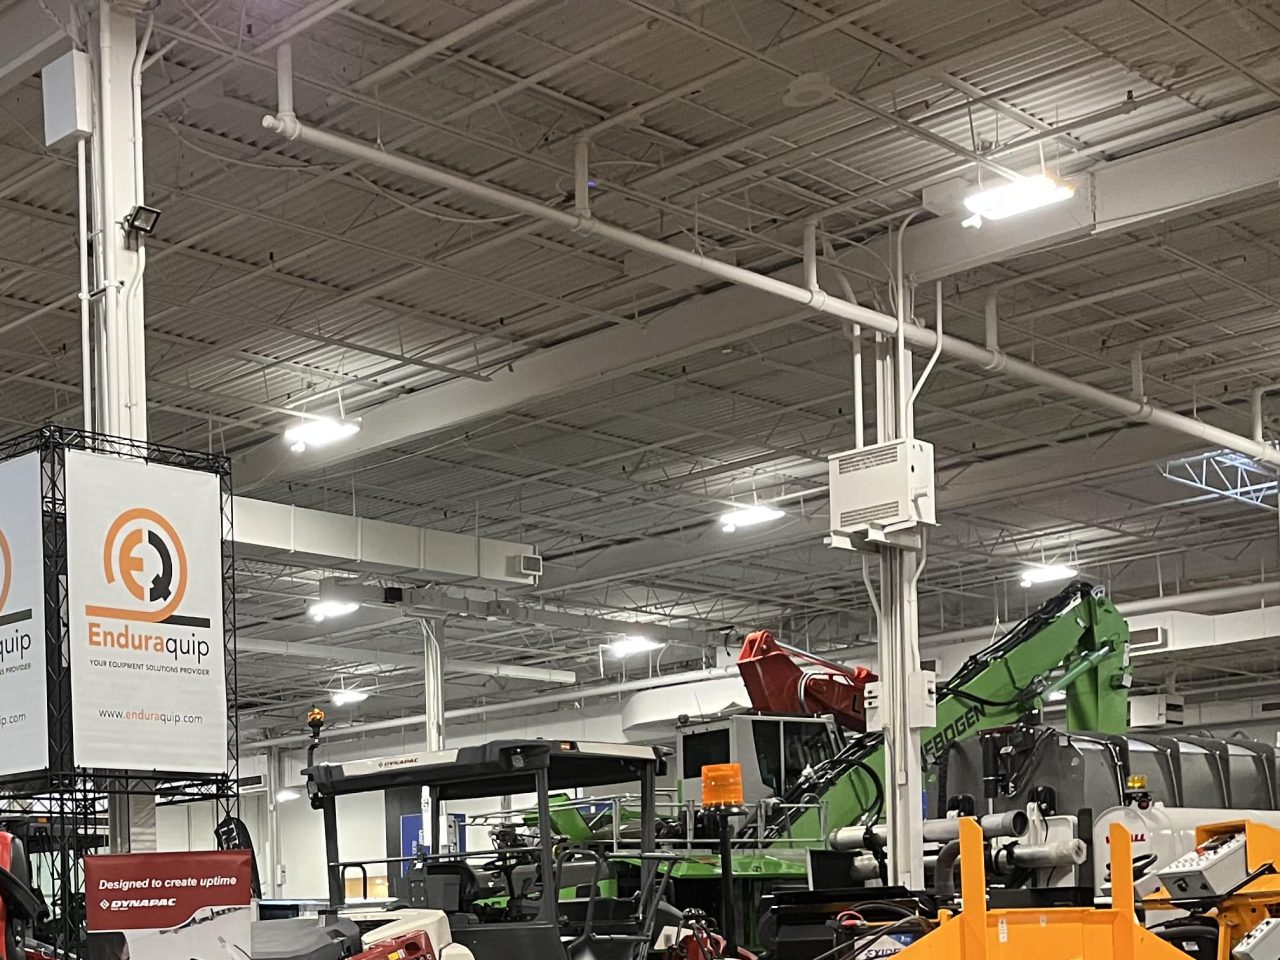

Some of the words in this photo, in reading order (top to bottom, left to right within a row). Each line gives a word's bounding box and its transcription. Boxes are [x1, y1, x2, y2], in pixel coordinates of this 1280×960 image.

[88, 622, 209, 664] Enduraquip
[6, 662, 32, 674] PROVIDER
[89, 659, 107, 667] YOUR
[108, 660, 144, 671] EQUIPMENT
[145, 666, 179, 674] SOLUTIONS
[180, 667, 210, 676] PROVIDER
[98, 708, 203, 724] www.enduraquip.com
[99, 879, 149, 891] Designed
[151, 879, 163, 888] to
[164, 877, 197, 887] create
[200, 875, 237, 889] uptime
[111, 897, 177, 909] DYNAPAC
